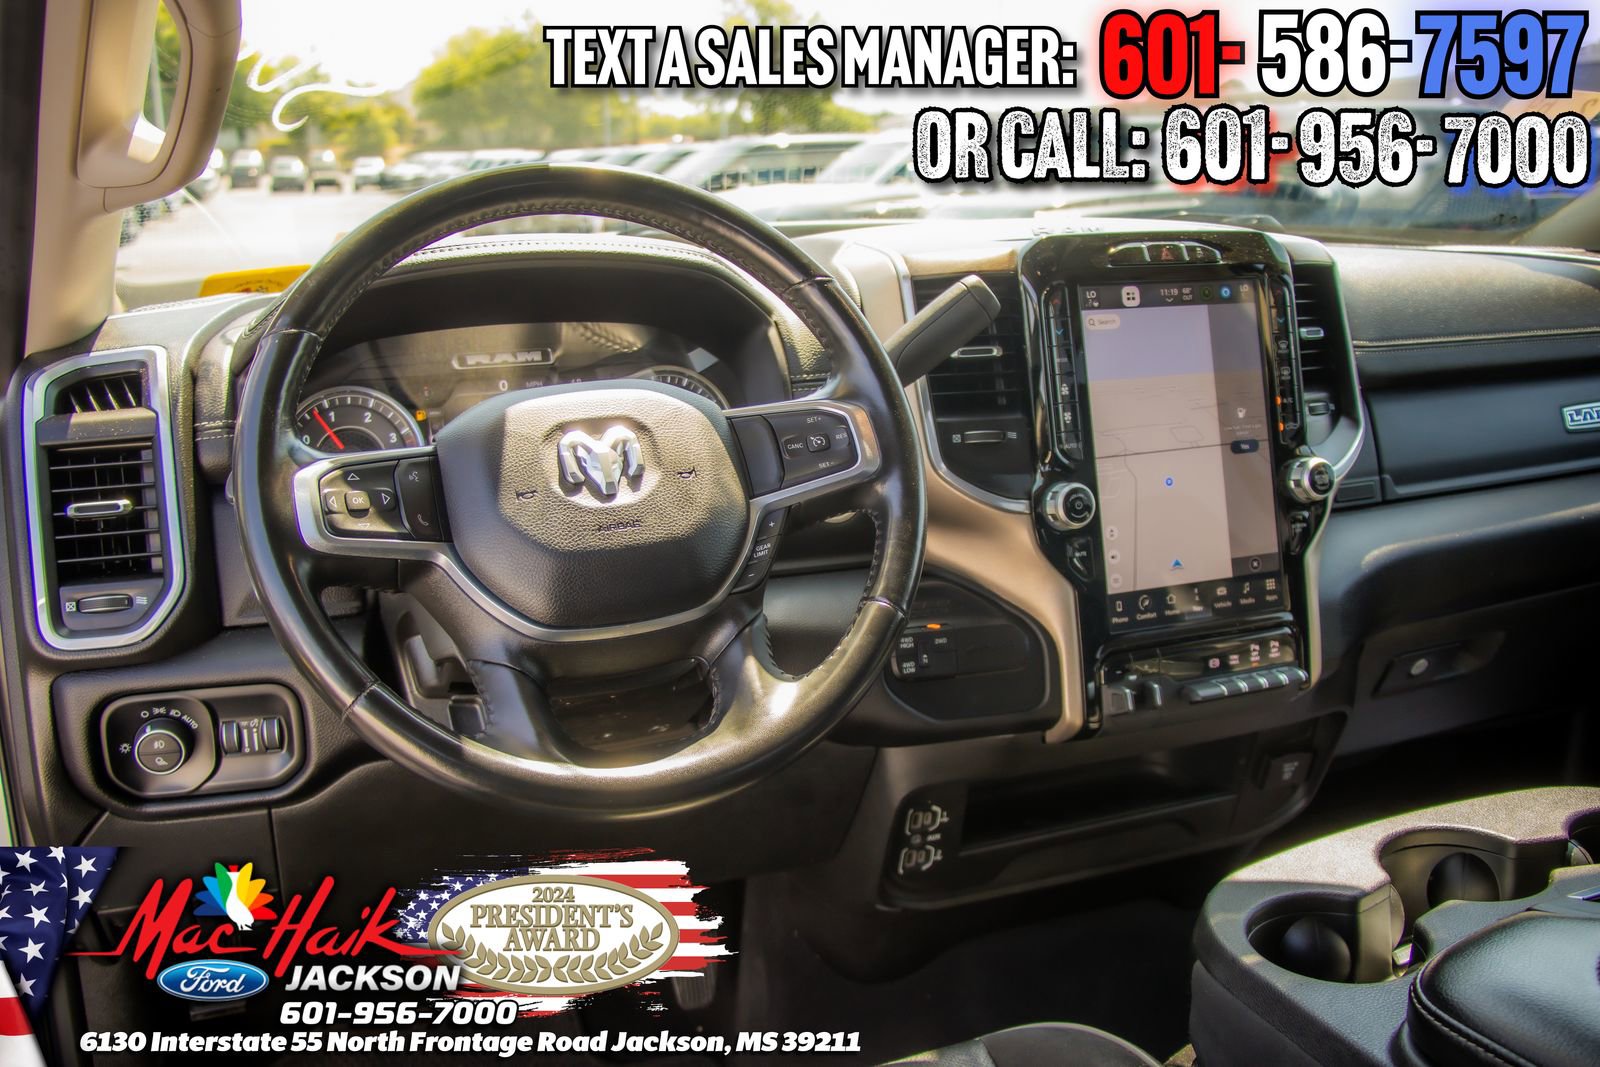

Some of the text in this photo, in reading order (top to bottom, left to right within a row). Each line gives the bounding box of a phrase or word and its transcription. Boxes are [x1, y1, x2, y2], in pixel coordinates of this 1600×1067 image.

[1159, 288, 1179, 297] 11:19
[465, 351, 542, 365] RAM
[498, 379, 509, 391] 0
[328, 411, 336, 422] 1
[363, 411, 373, 423] 2
[302, 434, 311, 445] 0
[388, 432, 398, 444] 3
[787, 442, 804, 450] CANC
[755, 542, 771, 551] GEAR
[753, 549, 769, 558] LIMIT
[182, 714, 198, 730] AUTO
